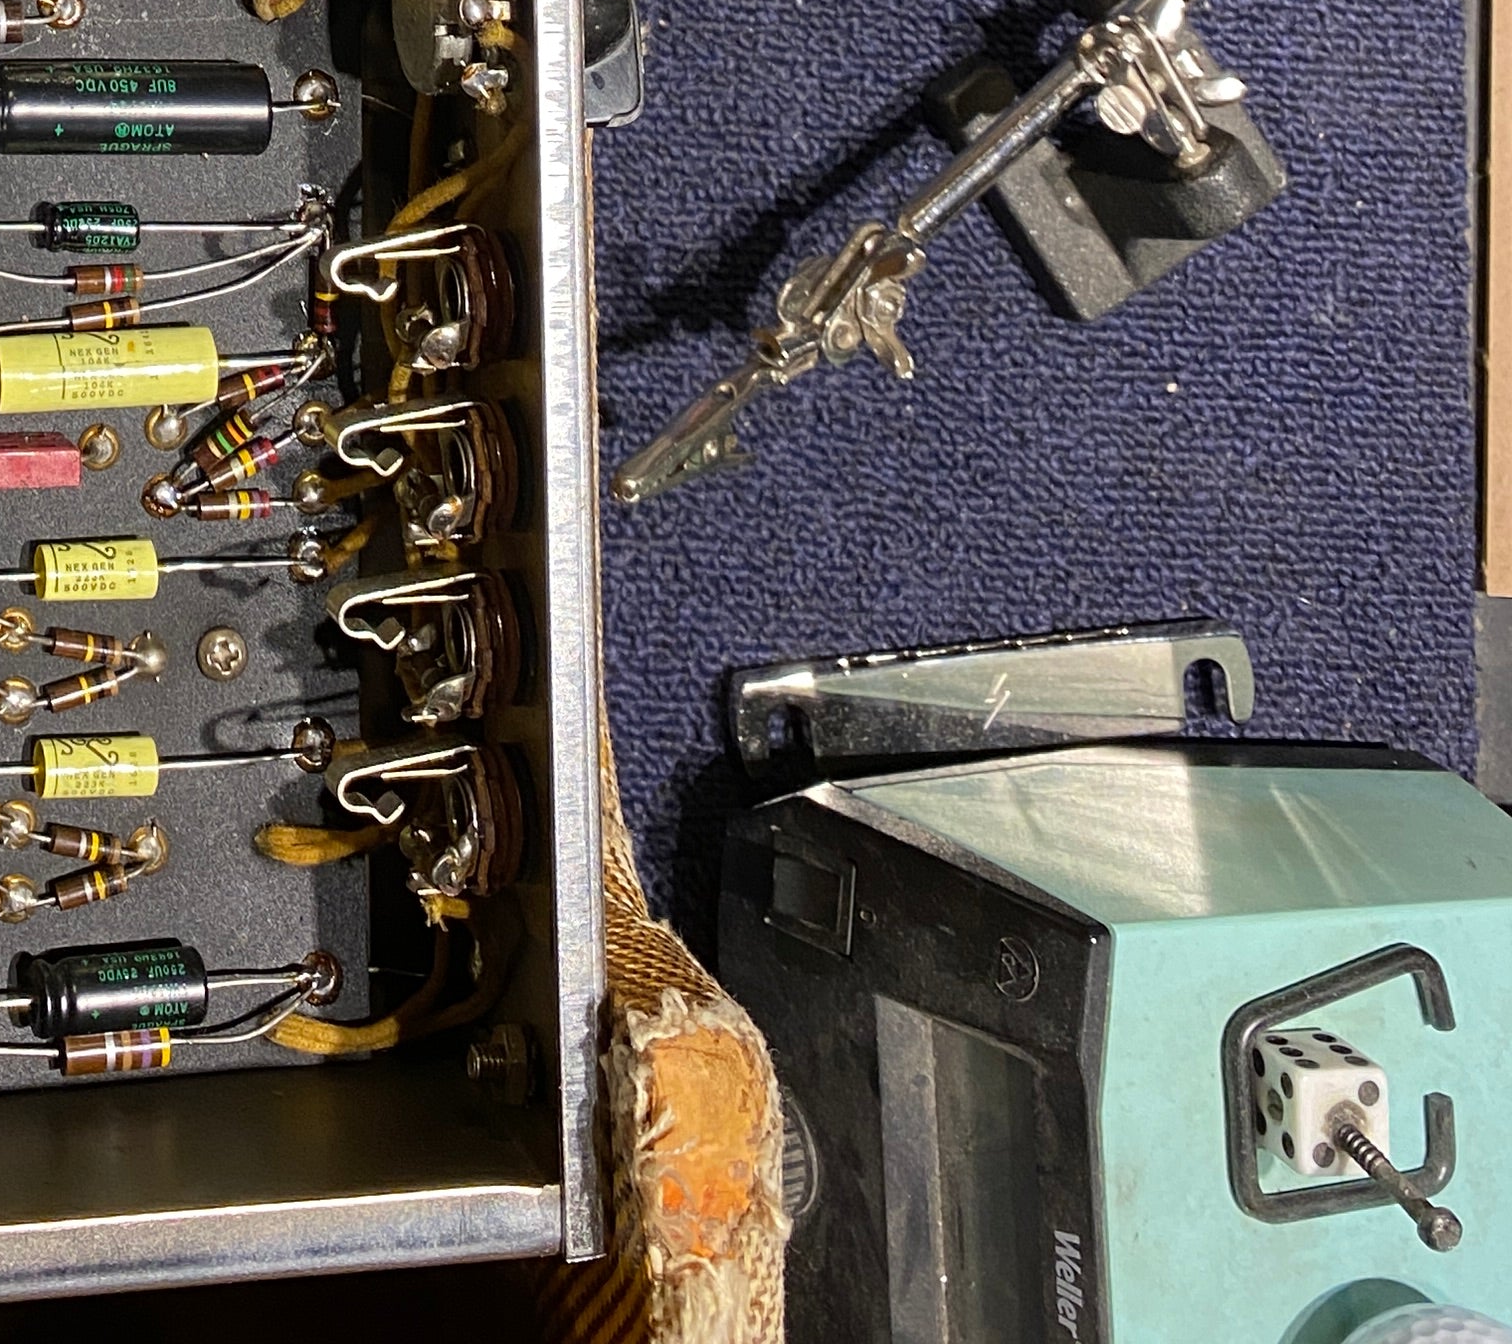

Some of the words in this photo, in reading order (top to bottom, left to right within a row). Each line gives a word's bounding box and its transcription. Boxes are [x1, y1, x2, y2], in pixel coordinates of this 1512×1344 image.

[75, 78, 107, 93] VDC
[109, 79, 138, 94] 450
[148, 79, 177, 94] 8UF
[98, 142, 173, 153] SPRAGUE
[68, 348, 93, 358] NEX
[95, 346, 120, 356] GEN
[71, 389, 125, 400] 500VDC
[64, 562, 88, 573] NEX
[63, 581, 117, 593] 500VDC
[1053, 1229, 1084, 1340] Weller
